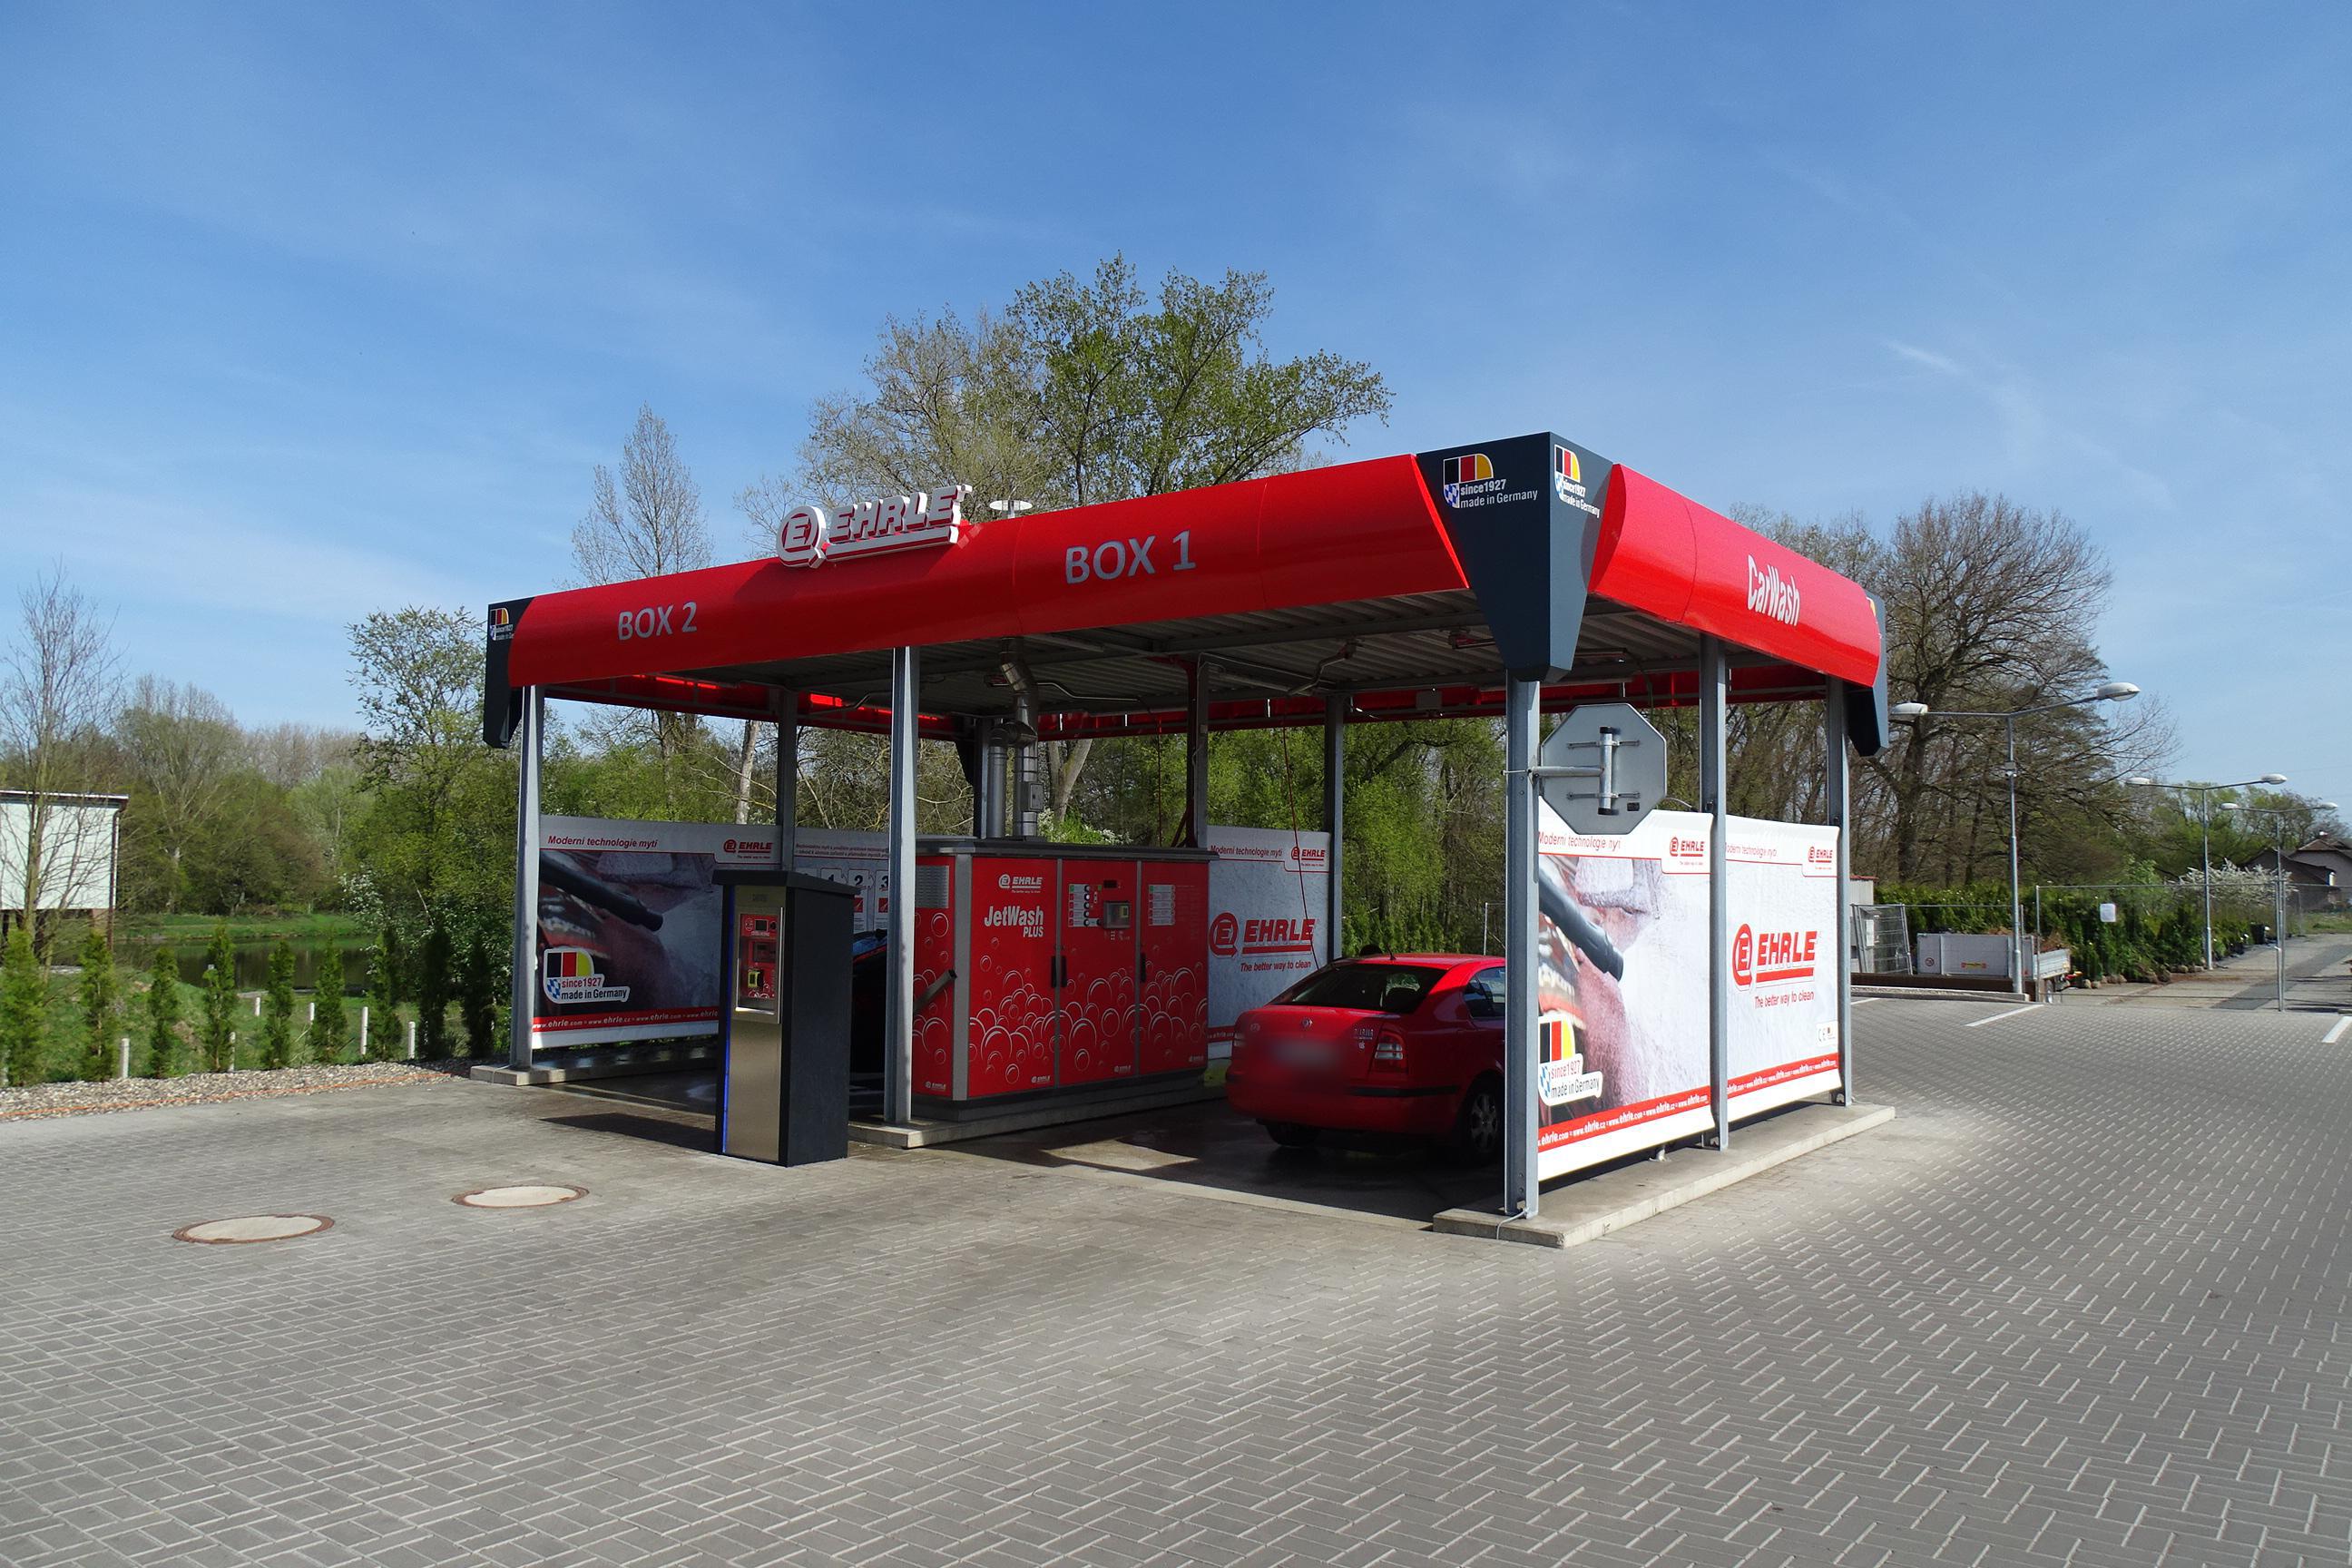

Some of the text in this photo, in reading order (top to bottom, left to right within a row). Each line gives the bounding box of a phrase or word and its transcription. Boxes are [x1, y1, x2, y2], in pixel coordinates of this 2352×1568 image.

[1461, 479, 1506, 495] since1927
[1461, 490, 1538, 508] made in Germany
[828, 485, 960, 544] EHRLE
[1581, 499, 1600, 518] Germany
[1065, 530, 1196, 584] BOX 1
[1748, 554, 1800, 626] CarWash
[618, 602, 698, 641] BOX 2
[587, 838, 637, 848] technologie
[1567, 835, 1606, 851] technologie
[1681, 841, 1705, 852] EHRLE
[1236, 847, 1269, 858] technologie
[1302, 849, 1325, 858] EHRLE
[854, 875, 863, 886] 2
[1012, 877, 1043, 885] EHRLE
[984, 906, 1044, 926] JetWash
[1023, 926, 1044, 937] PLUS
[1244, 919, 1315, 942] EHRLE
[1757, 930, 1818, 965] EHRLE
[1240, 960, 1311, 972] The better way to clean
[562, 977, 602, 988] since1927
[562, 988, 627, 999] made in Germany
[1755, 990, 1814, 1008] The better way to clean
[1552, 1060, 1581, 1079] since1927
[1552, 1078, 1600, 1098] made in Germany
